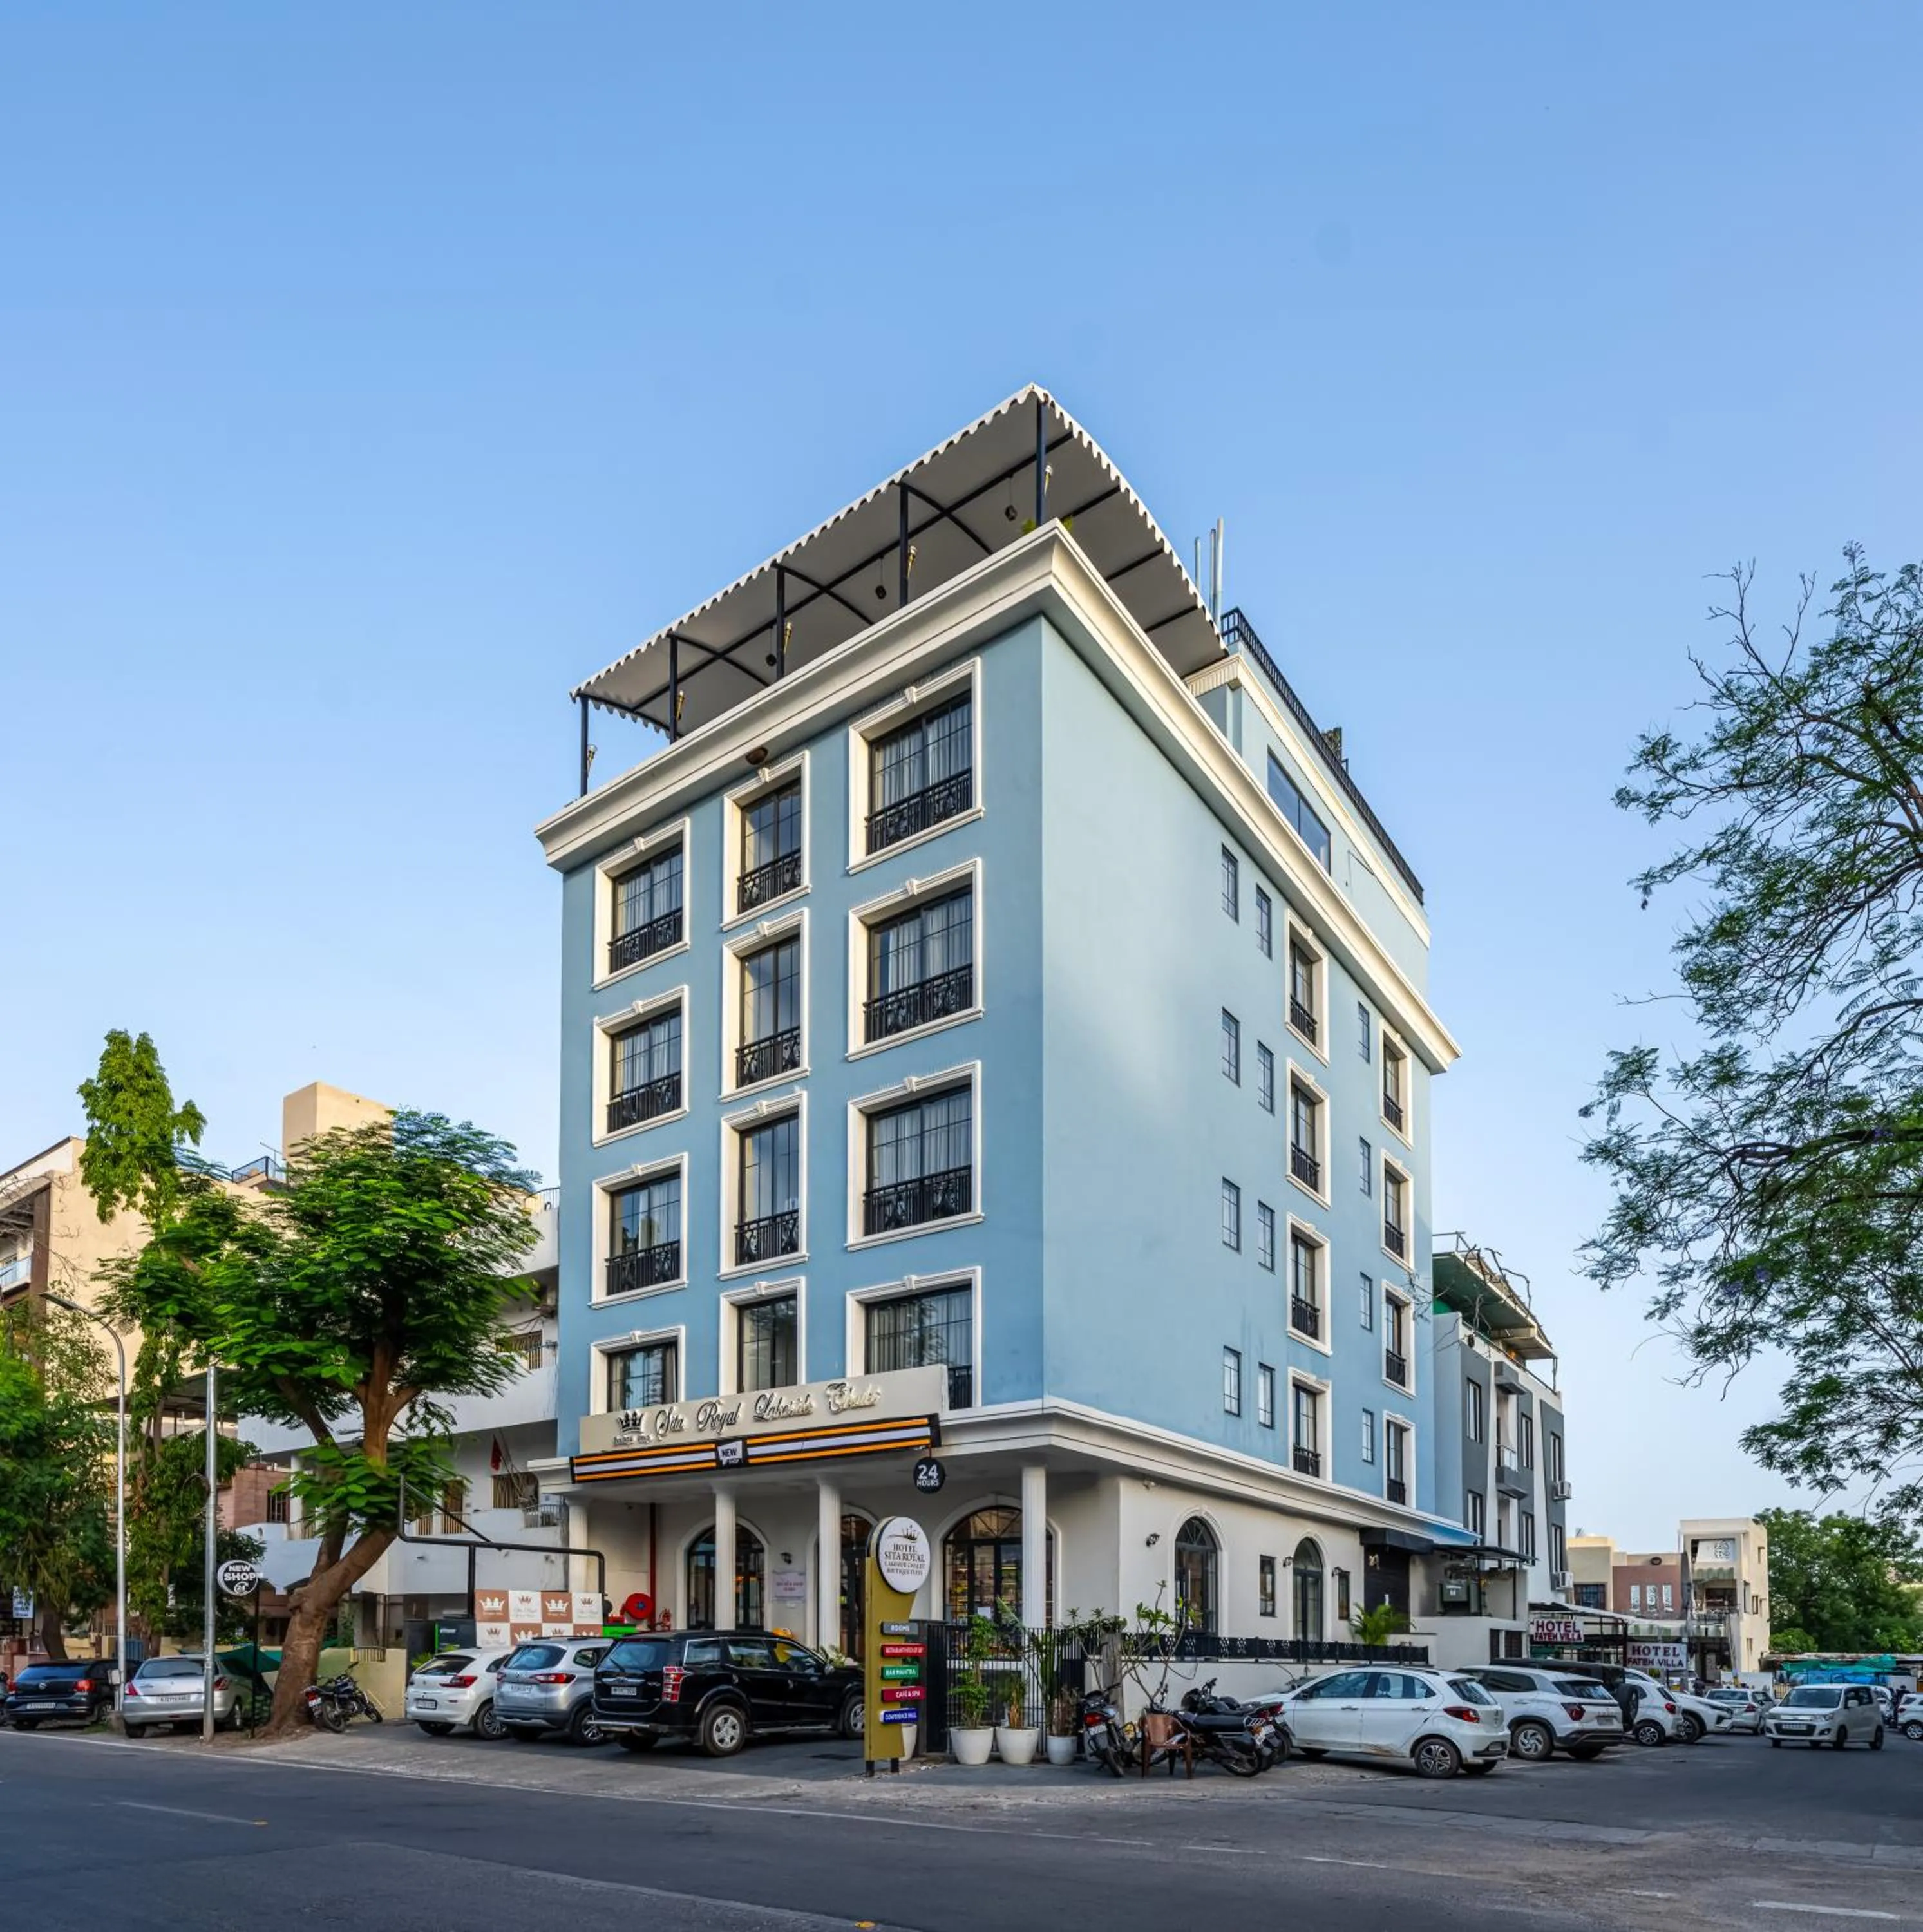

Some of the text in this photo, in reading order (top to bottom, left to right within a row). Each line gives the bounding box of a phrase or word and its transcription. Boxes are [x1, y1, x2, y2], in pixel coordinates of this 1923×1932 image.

[656, 1406, 685, 1441] Sita
[697, 1401, 741, 1435] Royal
[722, 1448, 737, 1457] NEW
[918, 1464, 938, 1479] 24
[893, 1544, 917, 1553] HOTEL
[884, 1551, 902, 1560] SITA
[224, 1572, 256, 1581] SHOP
[1536, 1620, 1580, 1633] HOTEL
[1535, 1633, 1582, 1641] FATEH VILLA
[1632, 1645, 1680, 1657] HOTEL
[1627, 1657, 1684, 1667] FATEH VILLA
